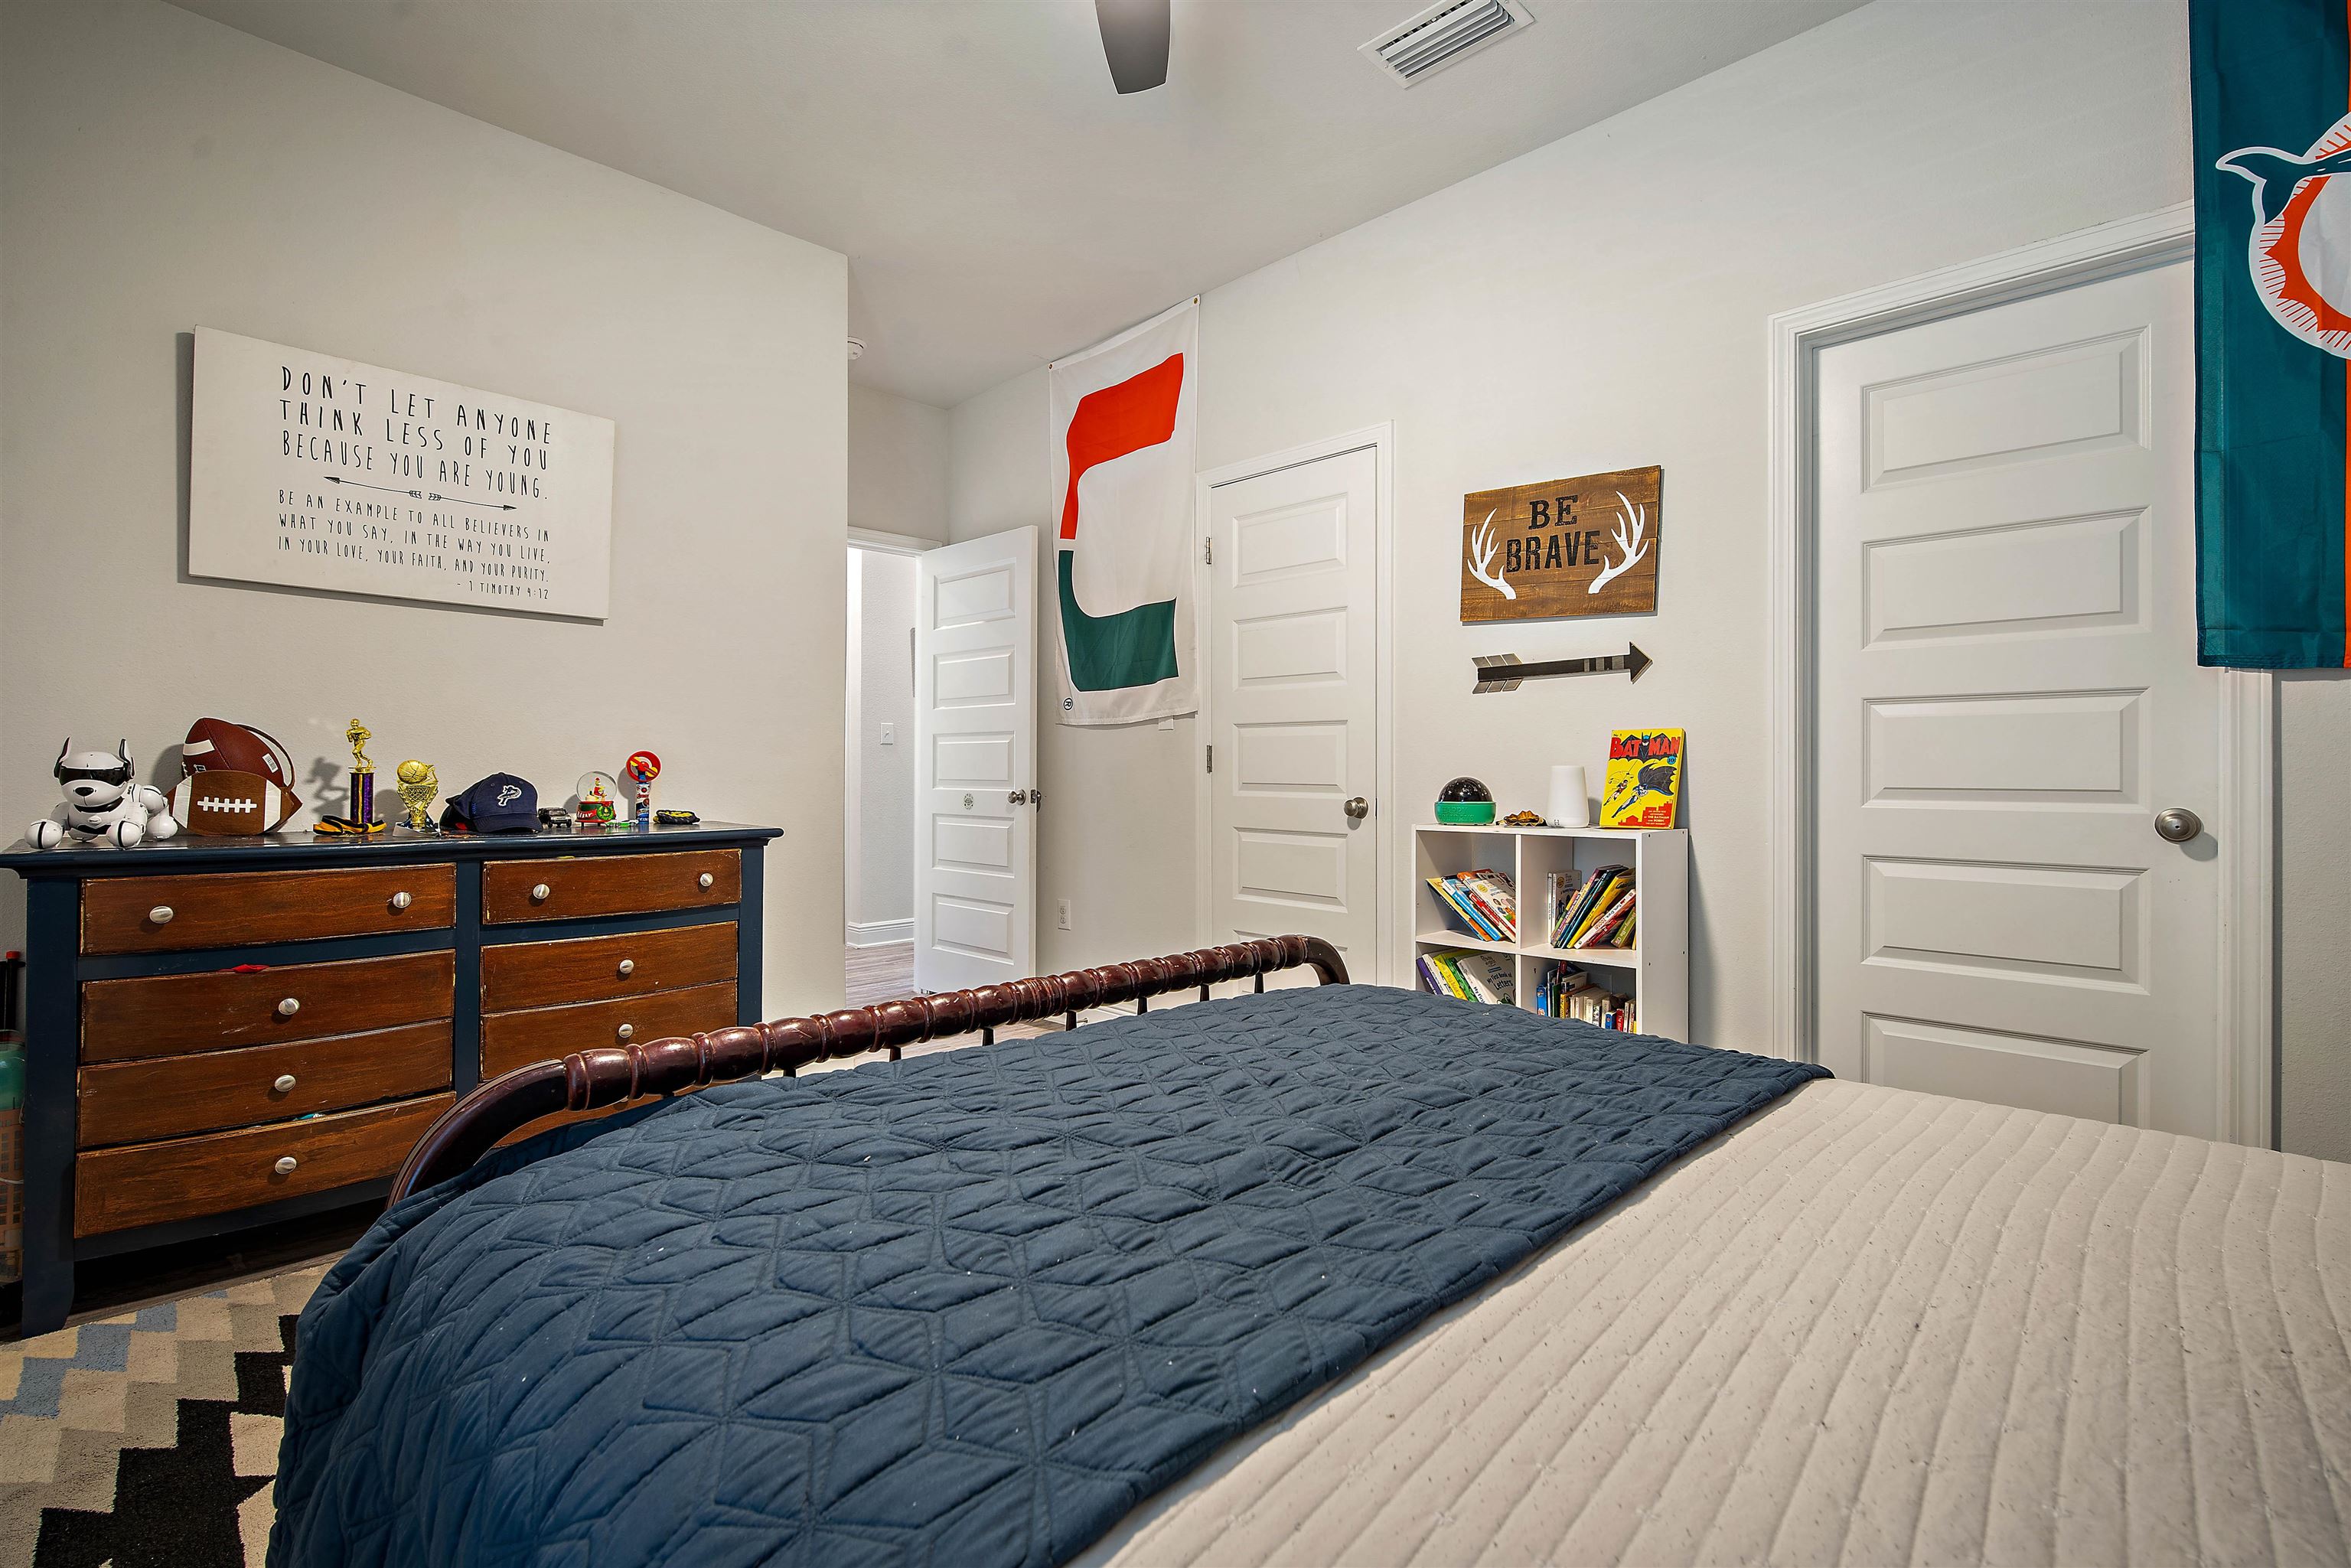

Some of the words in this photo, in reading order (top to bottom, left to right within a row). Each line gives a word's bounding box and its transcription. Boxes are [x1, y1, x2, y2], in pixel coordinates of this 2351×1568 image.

[280, 365, 368, 406] DON'T
[390, 388, 436, 419] LET
[455, 403, 552, 445] ANYONE
[279, 398, 364, 437] THINK
[385, 417, 444, 451] LESS
[464, 435, 488, 460] OF
[507, 444, 547, 471] YOU
[282, 429, 373, 471] BECAUSE
[389, 451, 423, 480] YOU
[438, 459, 471, 487] ARE
[278, 488, 295, 506] BE
[305, 493, 324, 510] AN
[334, 497, 399, 522] EXAMPLE
[407, 509, 423, 525] TO
[432, 512, 455, 530] ALL
[465, 517, 530, 540] BELIEVERS
[536, 528, 549, 543] IN
[1528, 495, 1578, 530] BE
[278, 512, 318, 531] WHAT
[326, 519, 353, 537] YOU
[403, 529, 418, 546] IN
[426, 532, 448, 549] THE
[457, 537, 482, 555] WAY
[490, 542, 512, 559] YOU
[278, 535, 291, 552] IN
[298, 538, 329, 556] YOUR
[376, 549, 405, 566] YOUR
[454, 557, 474, 574] AND
[480, 562, 505, 578] YOUR
[1506, 530, 1601, 573] BRAVE
[468, 579, 474, 592] 1
[479, 582, 521, 597] TIMOTHY
[526, 586, 549, 601] 4:12
[1472, 986, 1480, 994] My
[1493, 980, 1513, 990] Letters
